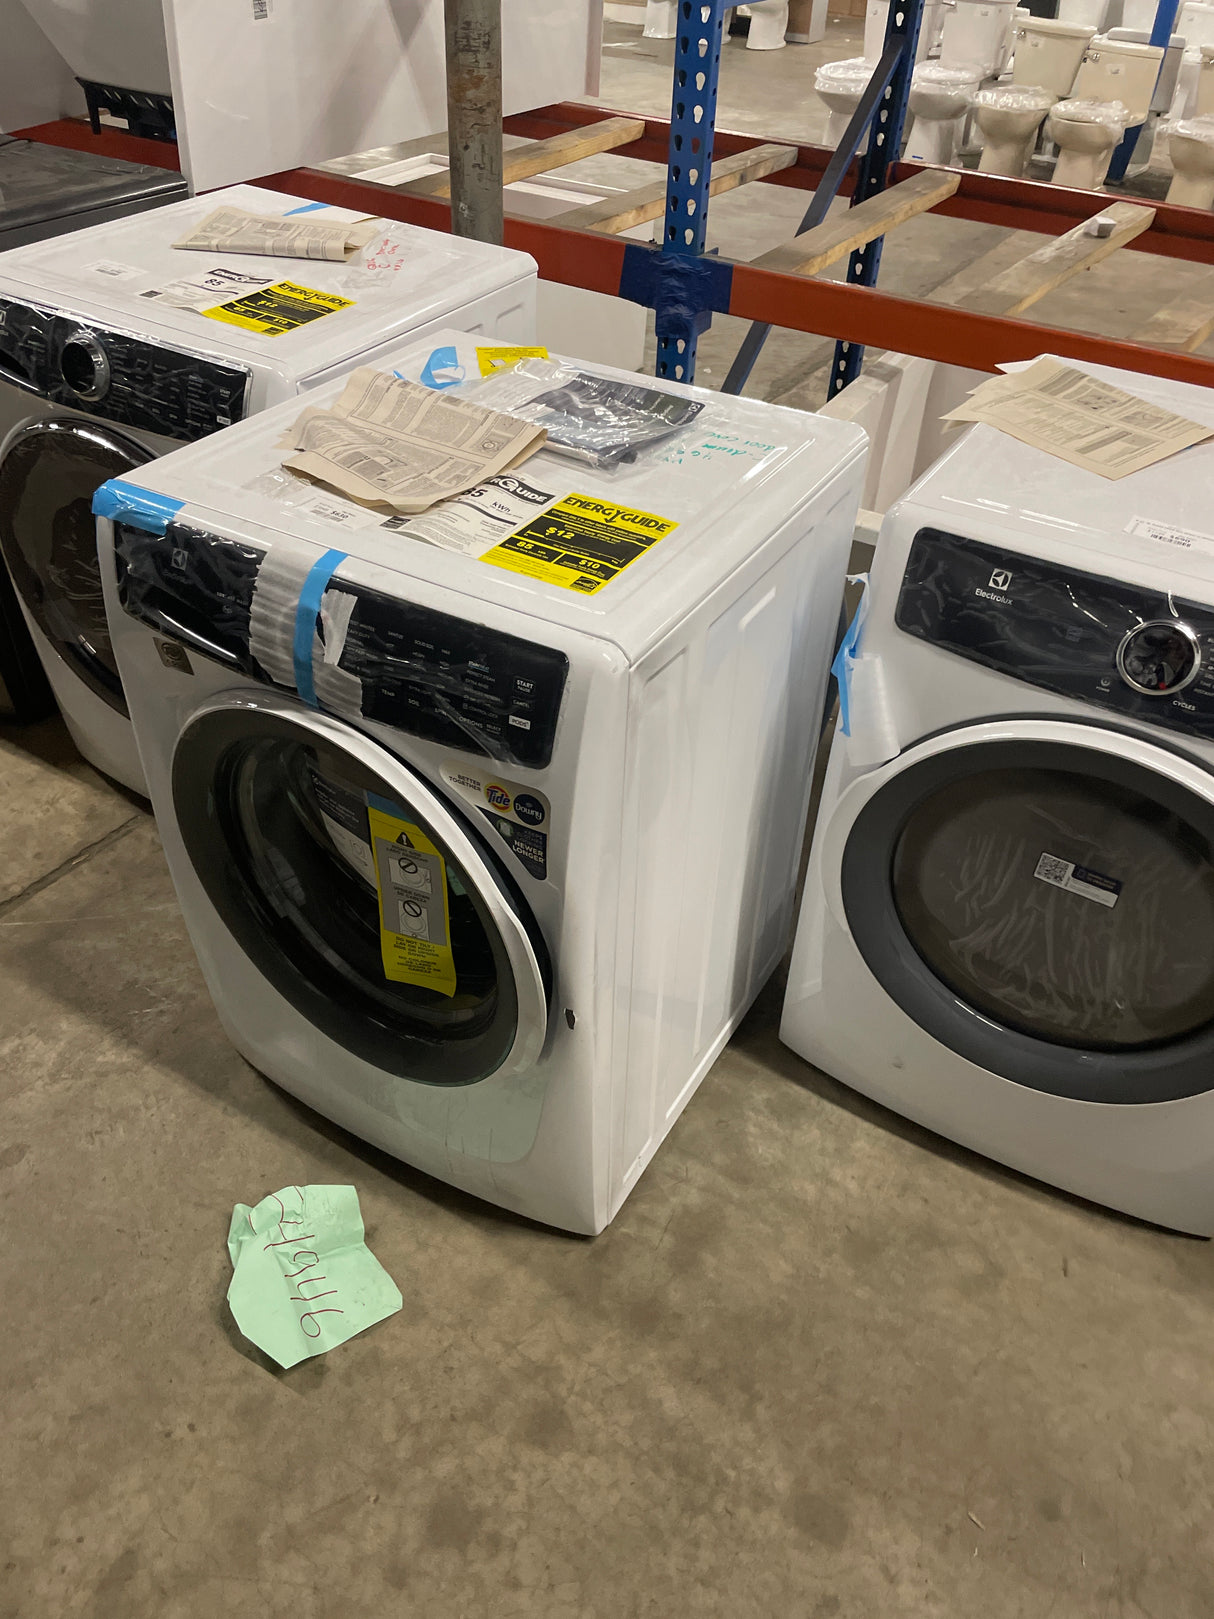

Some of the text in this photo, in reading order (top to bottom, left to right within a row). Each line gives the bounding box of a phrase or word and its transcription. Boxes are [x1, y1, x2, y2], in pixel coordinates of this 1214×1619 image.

[278, 283, 350, 307] ENERGYGUIDE
[492, 500, 511, 513] kWh
[563, 497, 671, 533] ENERGYGUIDE
[545, 526, 575, 540] $12
[578, 559, 601, 570] $10
[975, 588, 1014, 606] Electrolux
[516, 679, 534, 690] START
[1172, 700, 1196, 711] CYCLES
[458, 715, 484, 729] OPTIONS
[448, 775, 482, 792] TOGETHER
[457, 774, 481, 787] BETTER
[486, 787, 511, 806] Tide
[515, 802, 542, 820] Downy
[512, 844, 544, 864] LONGER
[514, 839, 544, 857] NEWER
